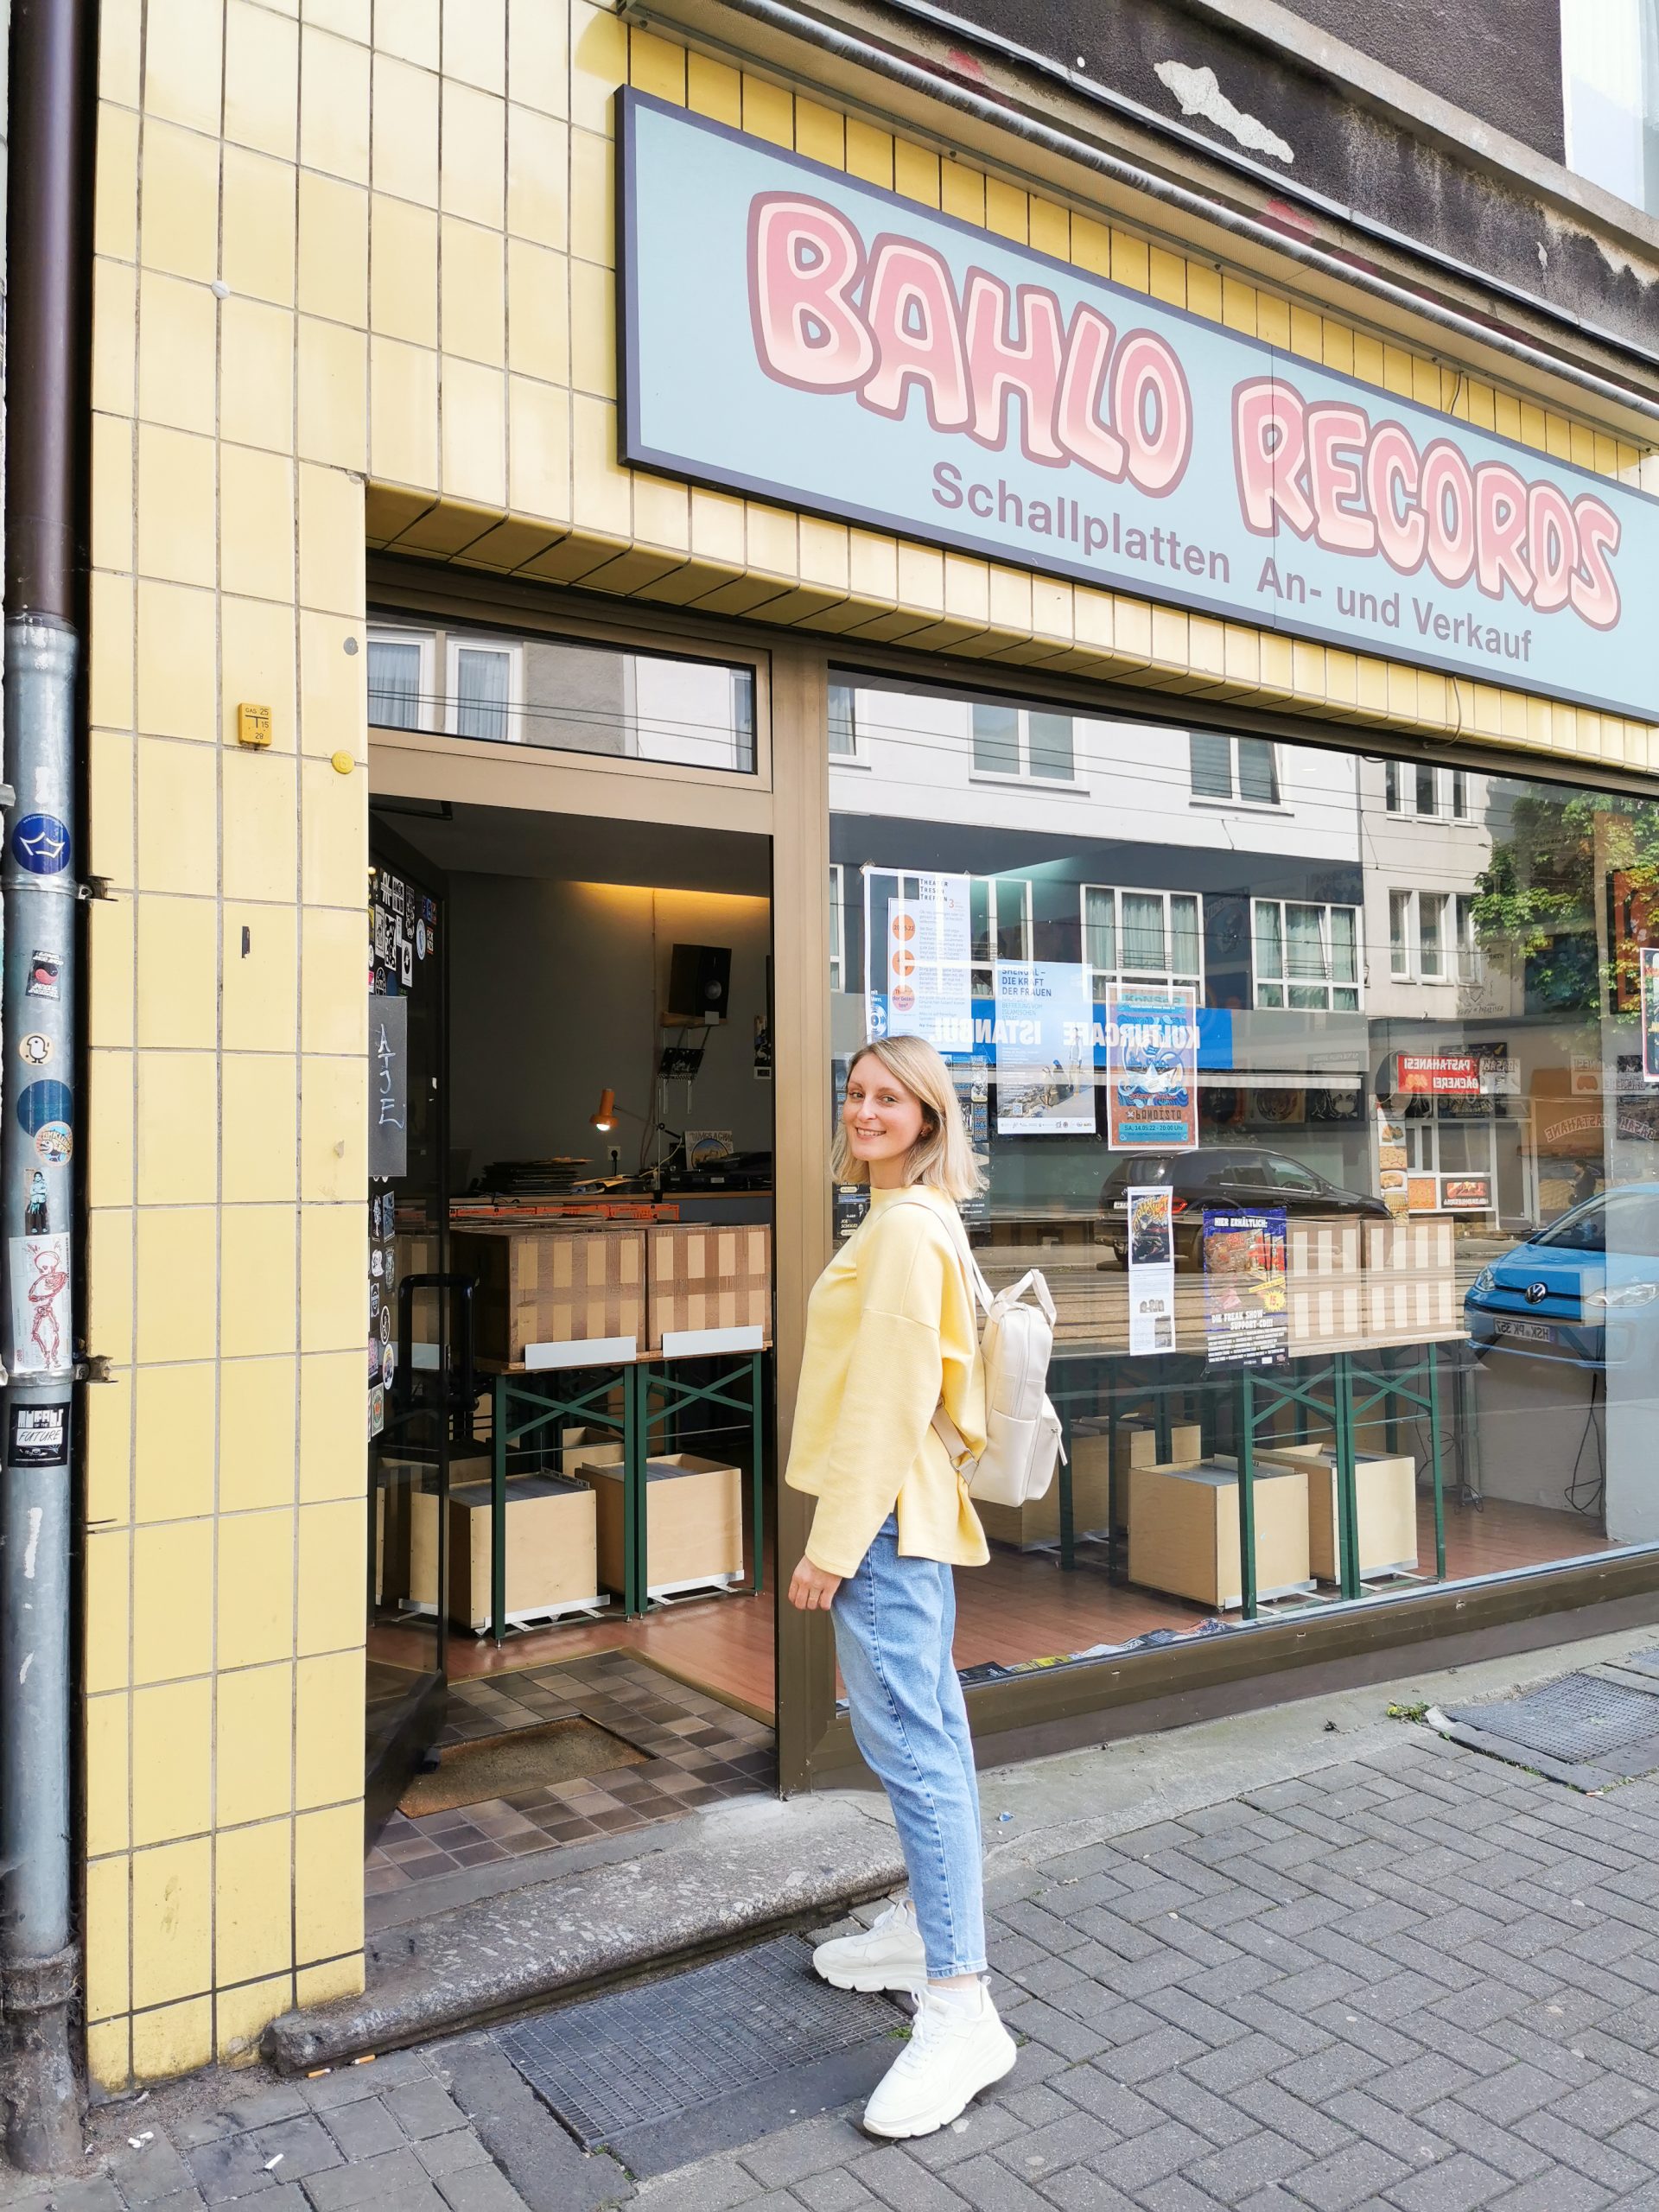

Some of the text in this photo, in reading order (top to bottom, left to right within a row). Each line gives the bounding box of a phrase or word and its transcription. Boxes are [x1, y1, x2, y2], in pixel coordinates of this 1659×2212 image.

[747, 191, 1621, 630] BAHLO RECORDS
[932, 461, 1532, 662] Schallplatten An- und Verkauf
[259, 708, 270, 716] 25
[920, 879, 948, 887] THEAR
[920, 893, 948, 902] TREFN
[1002, 976, 1016, 985] DIE
[1002, 987, 1018, 995] DER
[1214, 1216, 1268, 1228] HIER ERHÄLTLICH:
[1211, 1313, 1222, 1324] DIE
[1224, 1311, 1243, 1322] FREAK
[19, 1430, 61, 1442] FUTURE
